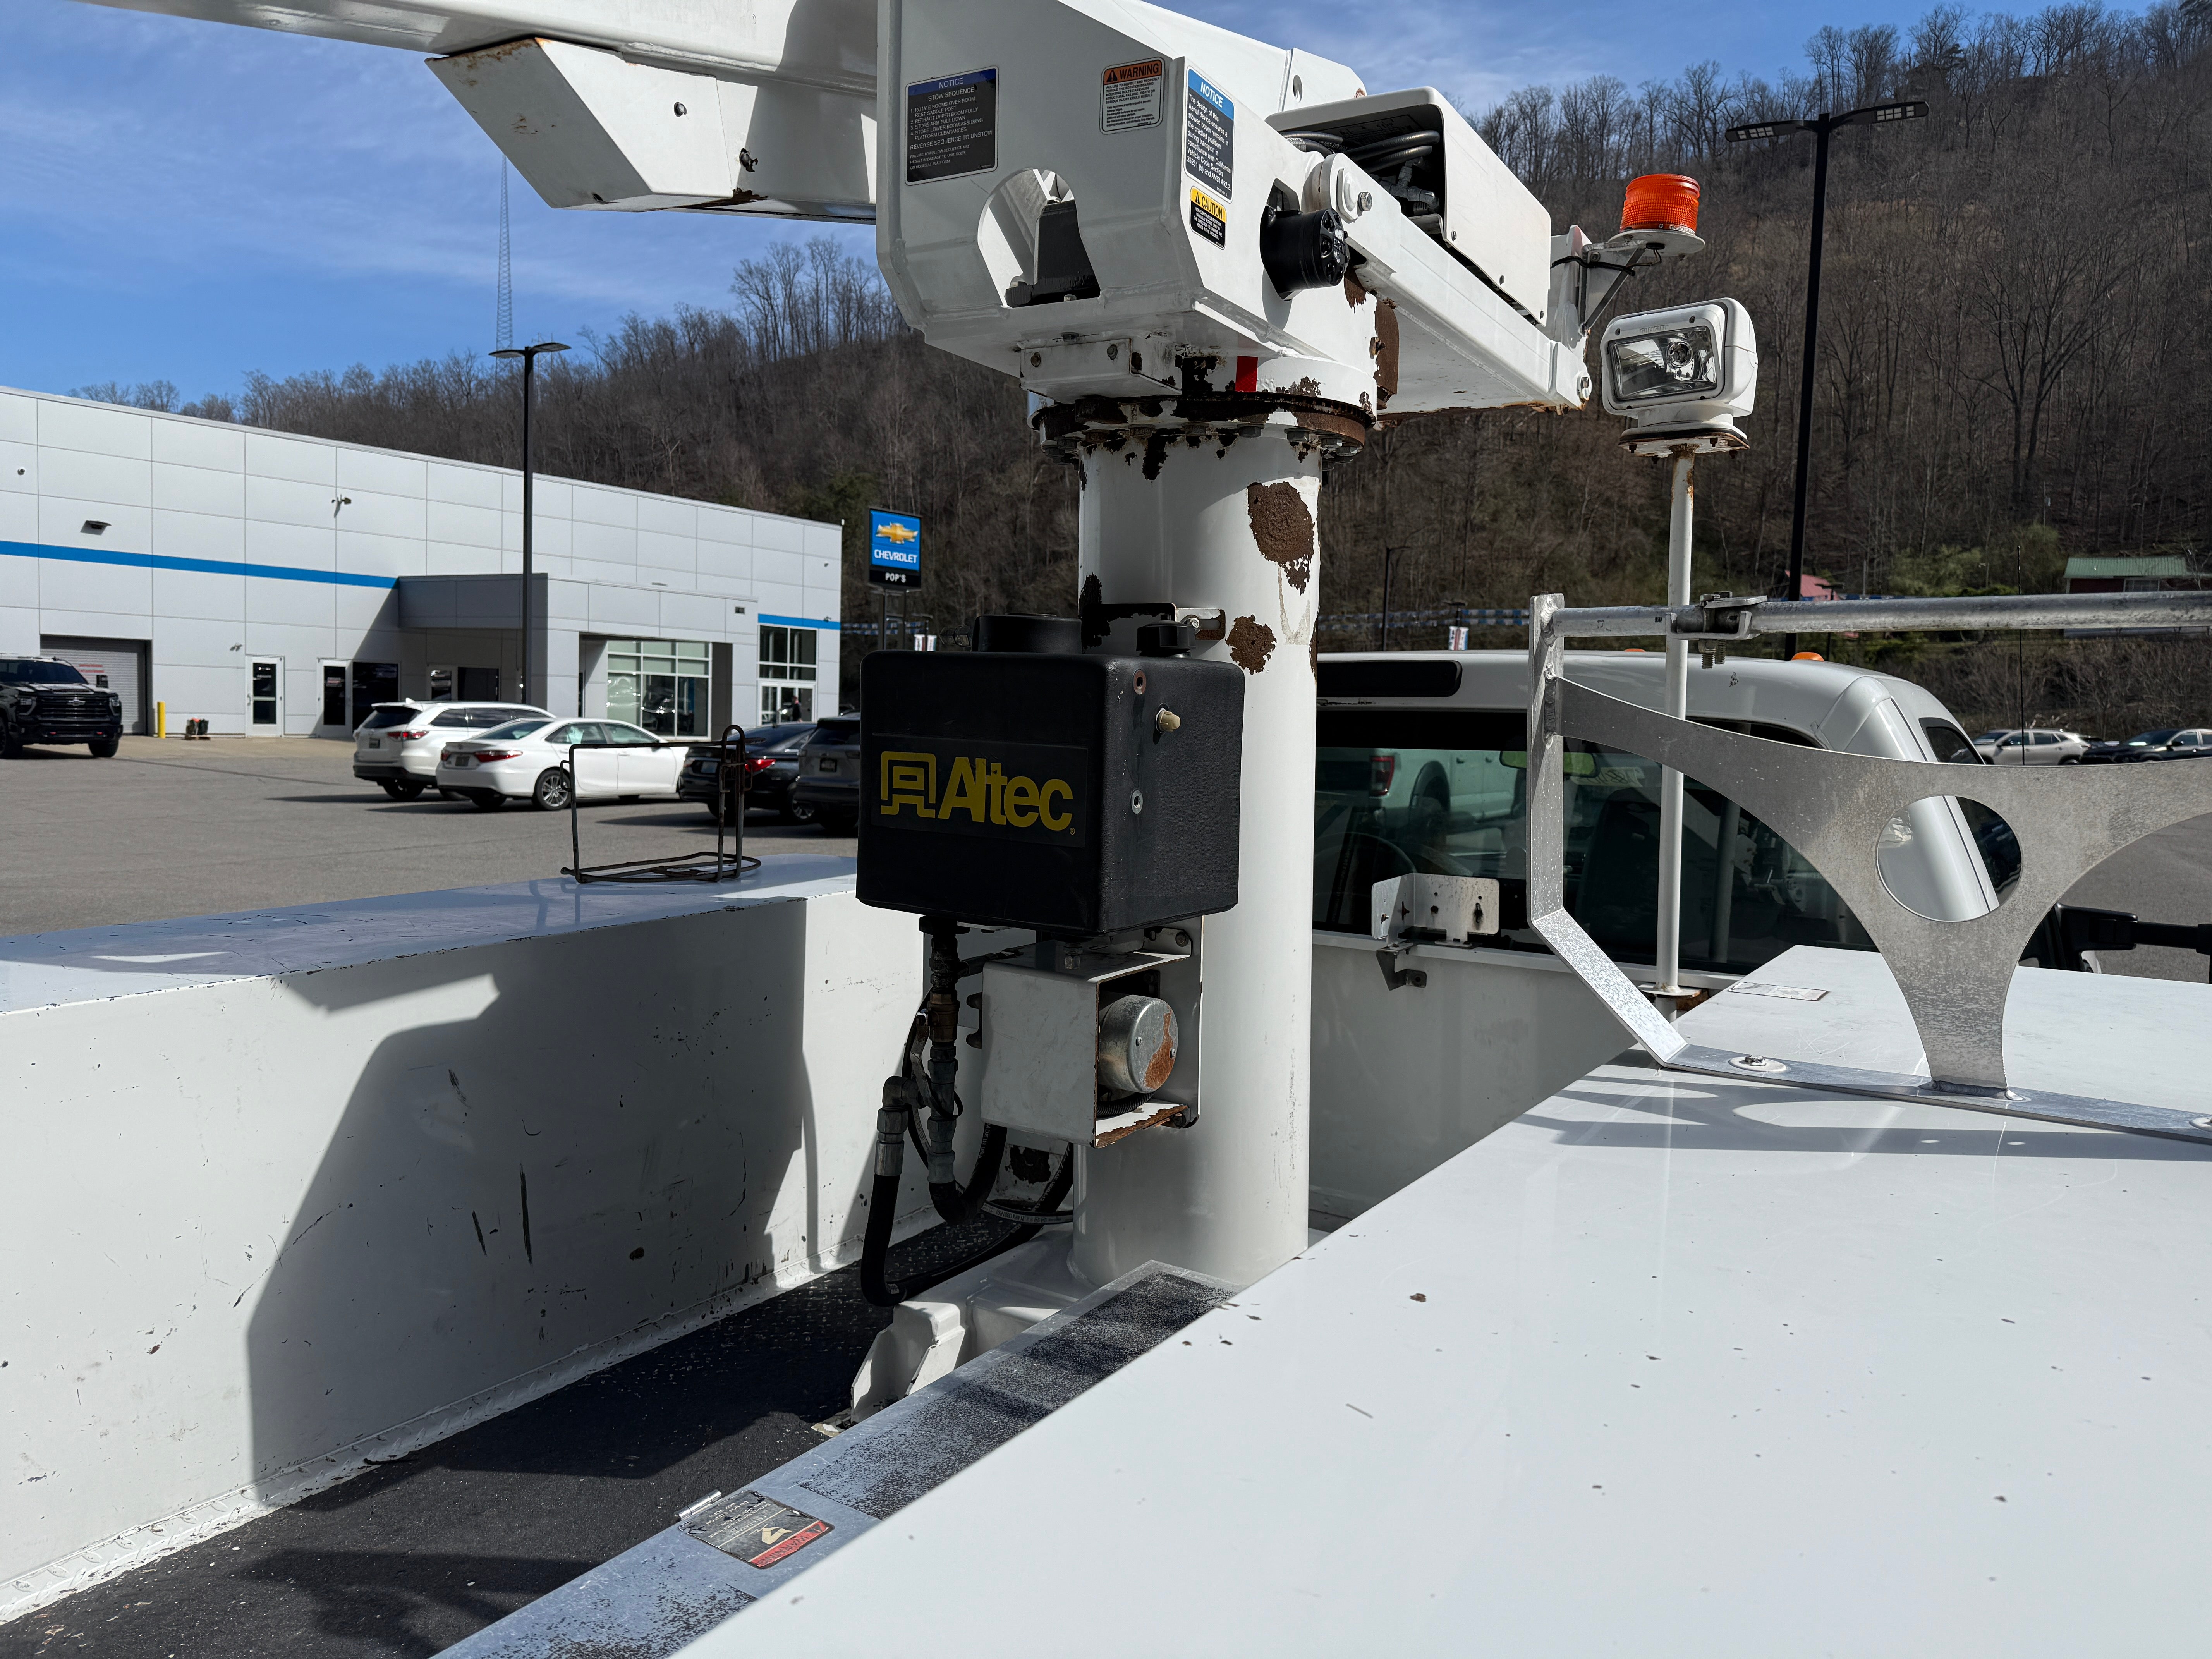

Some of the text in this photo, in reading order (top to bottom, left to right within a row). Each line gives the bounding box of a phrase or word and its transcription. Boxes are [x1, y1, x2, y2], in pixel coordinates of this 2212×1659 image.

[1120, 63, 1159, 80] WARNING
[928, 86, 974, 101] STOW SEQUENCE
[939, 78, 964, 89] NOTICE
[1200, 82, 1223, 108] NOTICE
[1197, 100, 1208, 113] design
[960, 118, 983, 126] ASSURING
[1188, 113, 1200, 126] stowed
[1201, 121, 1211, 133] boom
[1212, 131, 1224, 144] remains
[1189, 103, 1199, 115] Aerial
[1200, 112, 1211, 124] device
[1211, 121, 1224, 135] ensures
[910, 141, 933, 150] REVERSE
[934, 136, 961, 146] SEQUENCE
[970, 130, 993, 139] UNSTOW
[938, 127, 967, 136] CLEARANCES
[1188, 130, 1199, 144] during
[1200, 138, 1215, 154] transport
[1194, 127, 1207, 139] cradled
[1208, 136, 1221, 149] position
[1187, 146, 1223, 177] Vehicle Code Section
[1188, 139, 1207, 157] compliance
[1216, 158, 1231, 173] California
[1187, 156, 1197, 168] 35251
[1211, 173, 1220, 184] ANSI
[1202, 196, 1223, 219] CAUTION
[874, 549, 917, 563] CHEVROLET
[885, 572, 906, 583] POP'S
[937, 757, 1073, 831] Altec
[715, 1512, 729, 1520] STEP
[723, 1521, 738, 1530] could
[758, 1536, 808, 1565] WARNING
